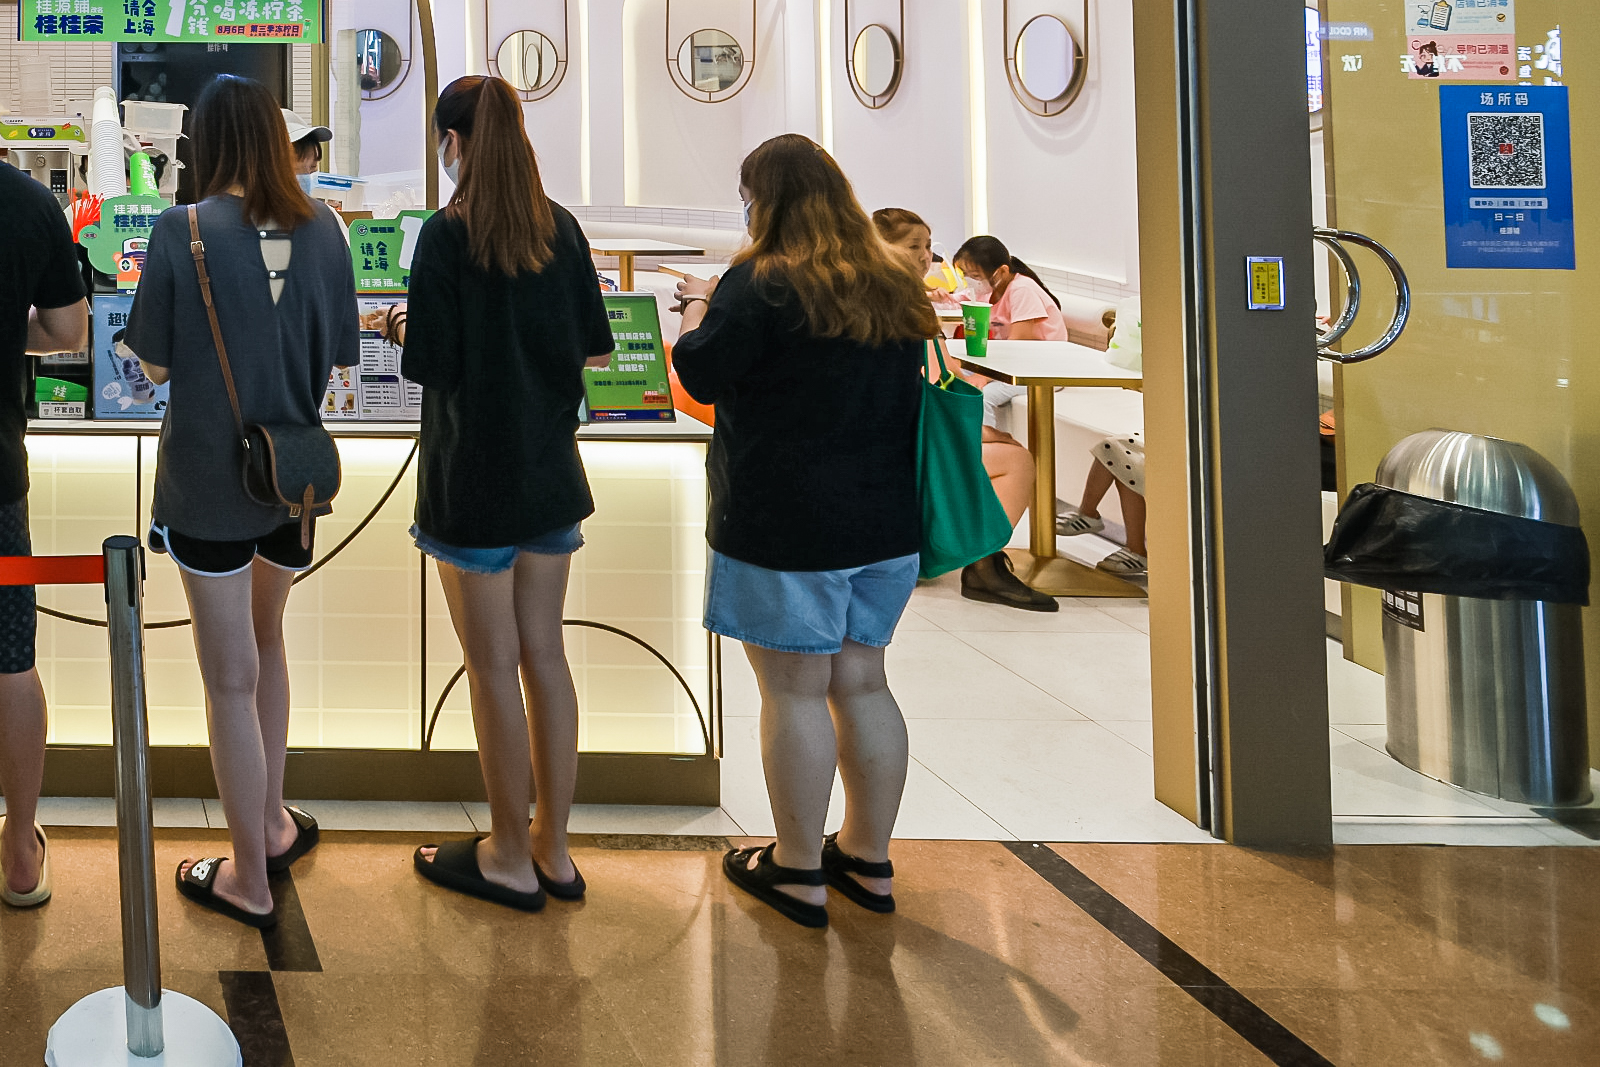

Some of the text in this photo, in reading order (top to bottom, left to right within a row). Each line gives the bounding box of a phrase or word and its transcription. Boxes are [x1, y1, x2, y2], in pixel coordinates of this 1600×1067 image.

[123, 18, 156, 36] 上海
[217, 24, 300, 35] 8月6日 第三季冻柠日
[1456, 44, 1509, 55] 导购已测温
[1480, 92, 1529, 106] 场所码
[360, 241, 387, 256] 请全
[363, 257, 389, 271] 上海
[53, 386, 67, 398] 桂
